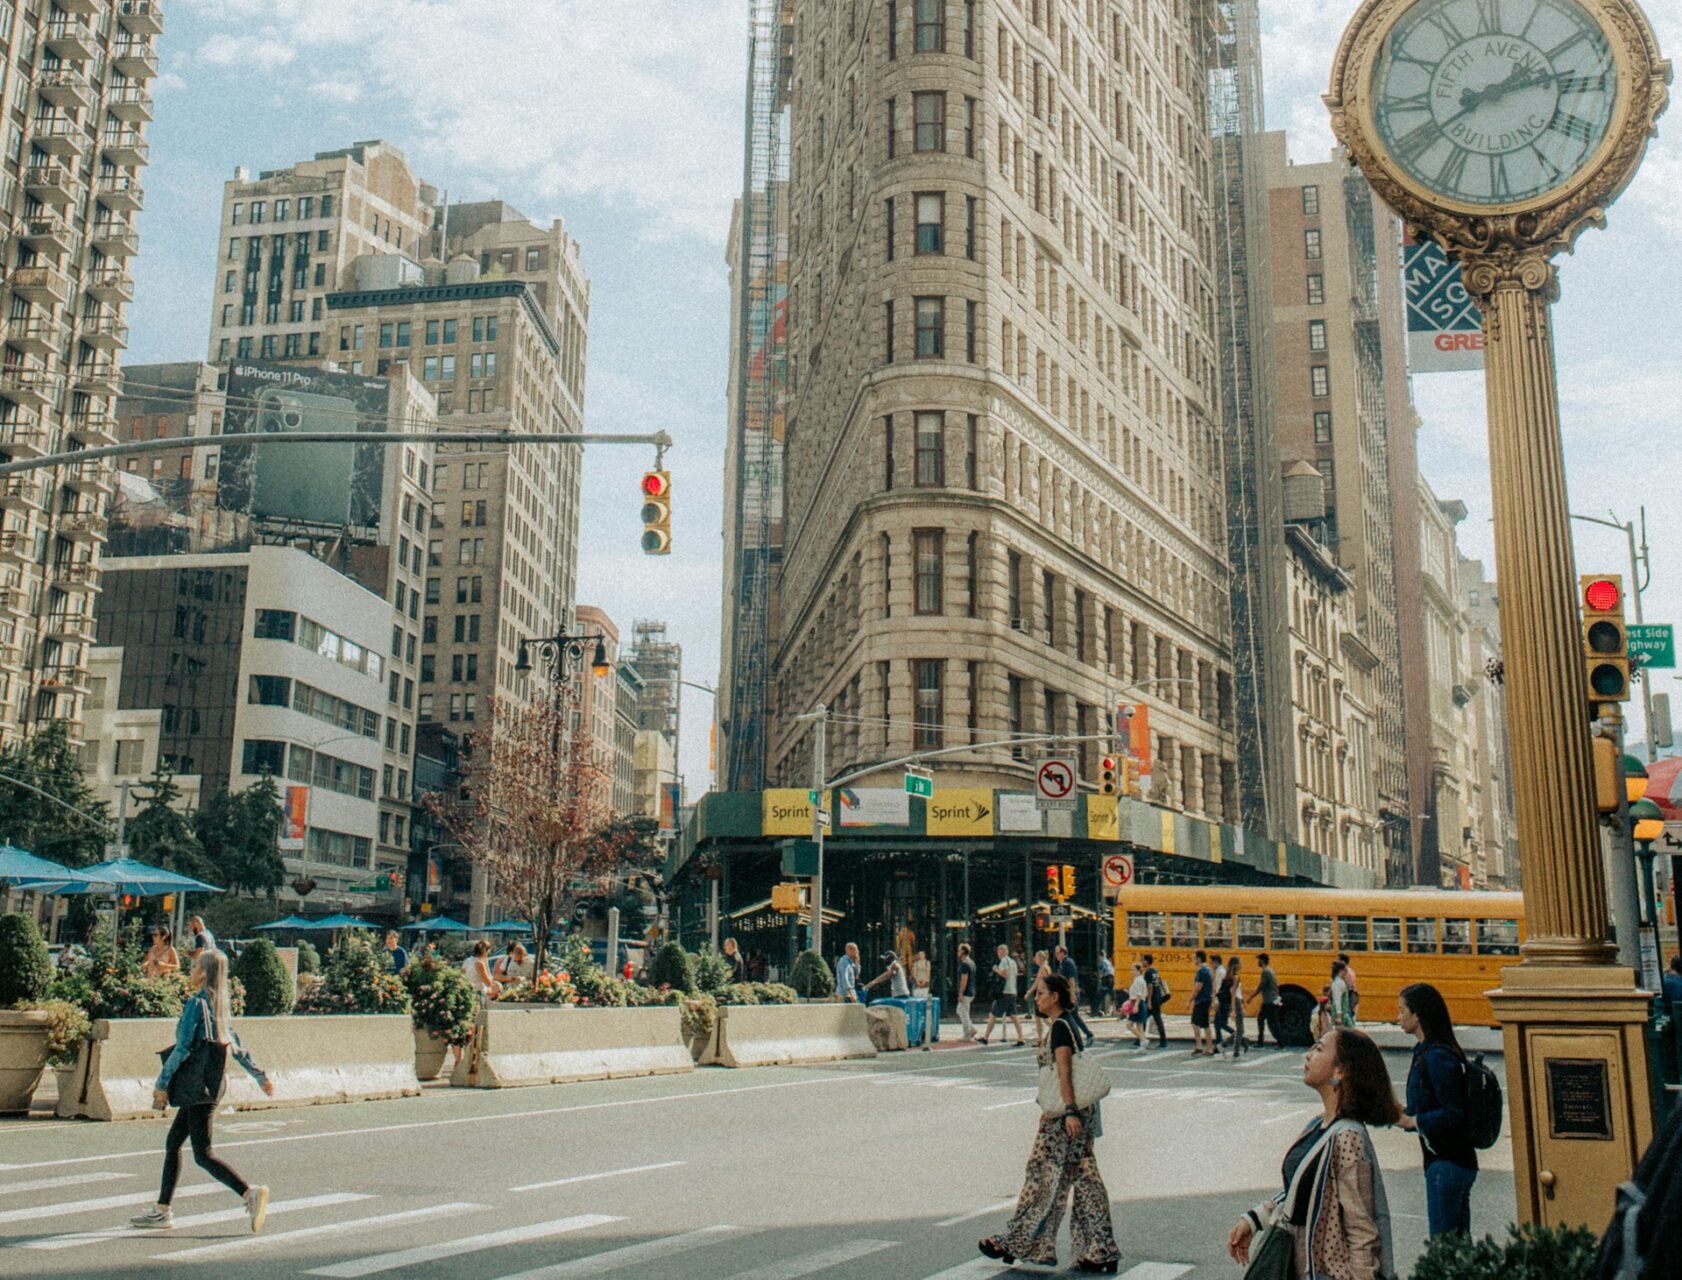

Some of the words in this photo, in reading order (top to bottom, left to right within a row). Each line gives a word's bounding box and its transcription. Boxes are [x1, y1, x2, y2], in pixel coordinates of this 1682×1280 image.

[1436, 49, 1475, 98] FIFTH
[1484, 41, 1547, 76] AVENU
[1451, 114, 1545, 151] BUILDING
[1405, 244, 1449, 297] MA
[1434, 333, 1485, 353] GRE
[244, 366, 281, 381] iPhone
[281, 371, 292, 383] 11
[293, 373, 311, 387] Pro
[1645, 628, 1669, 638] Side
[1626, 639, 1666, 652] ighway
[771, 805, 810, 820] Sprint
[931, 805, 971, 822] Sprint
